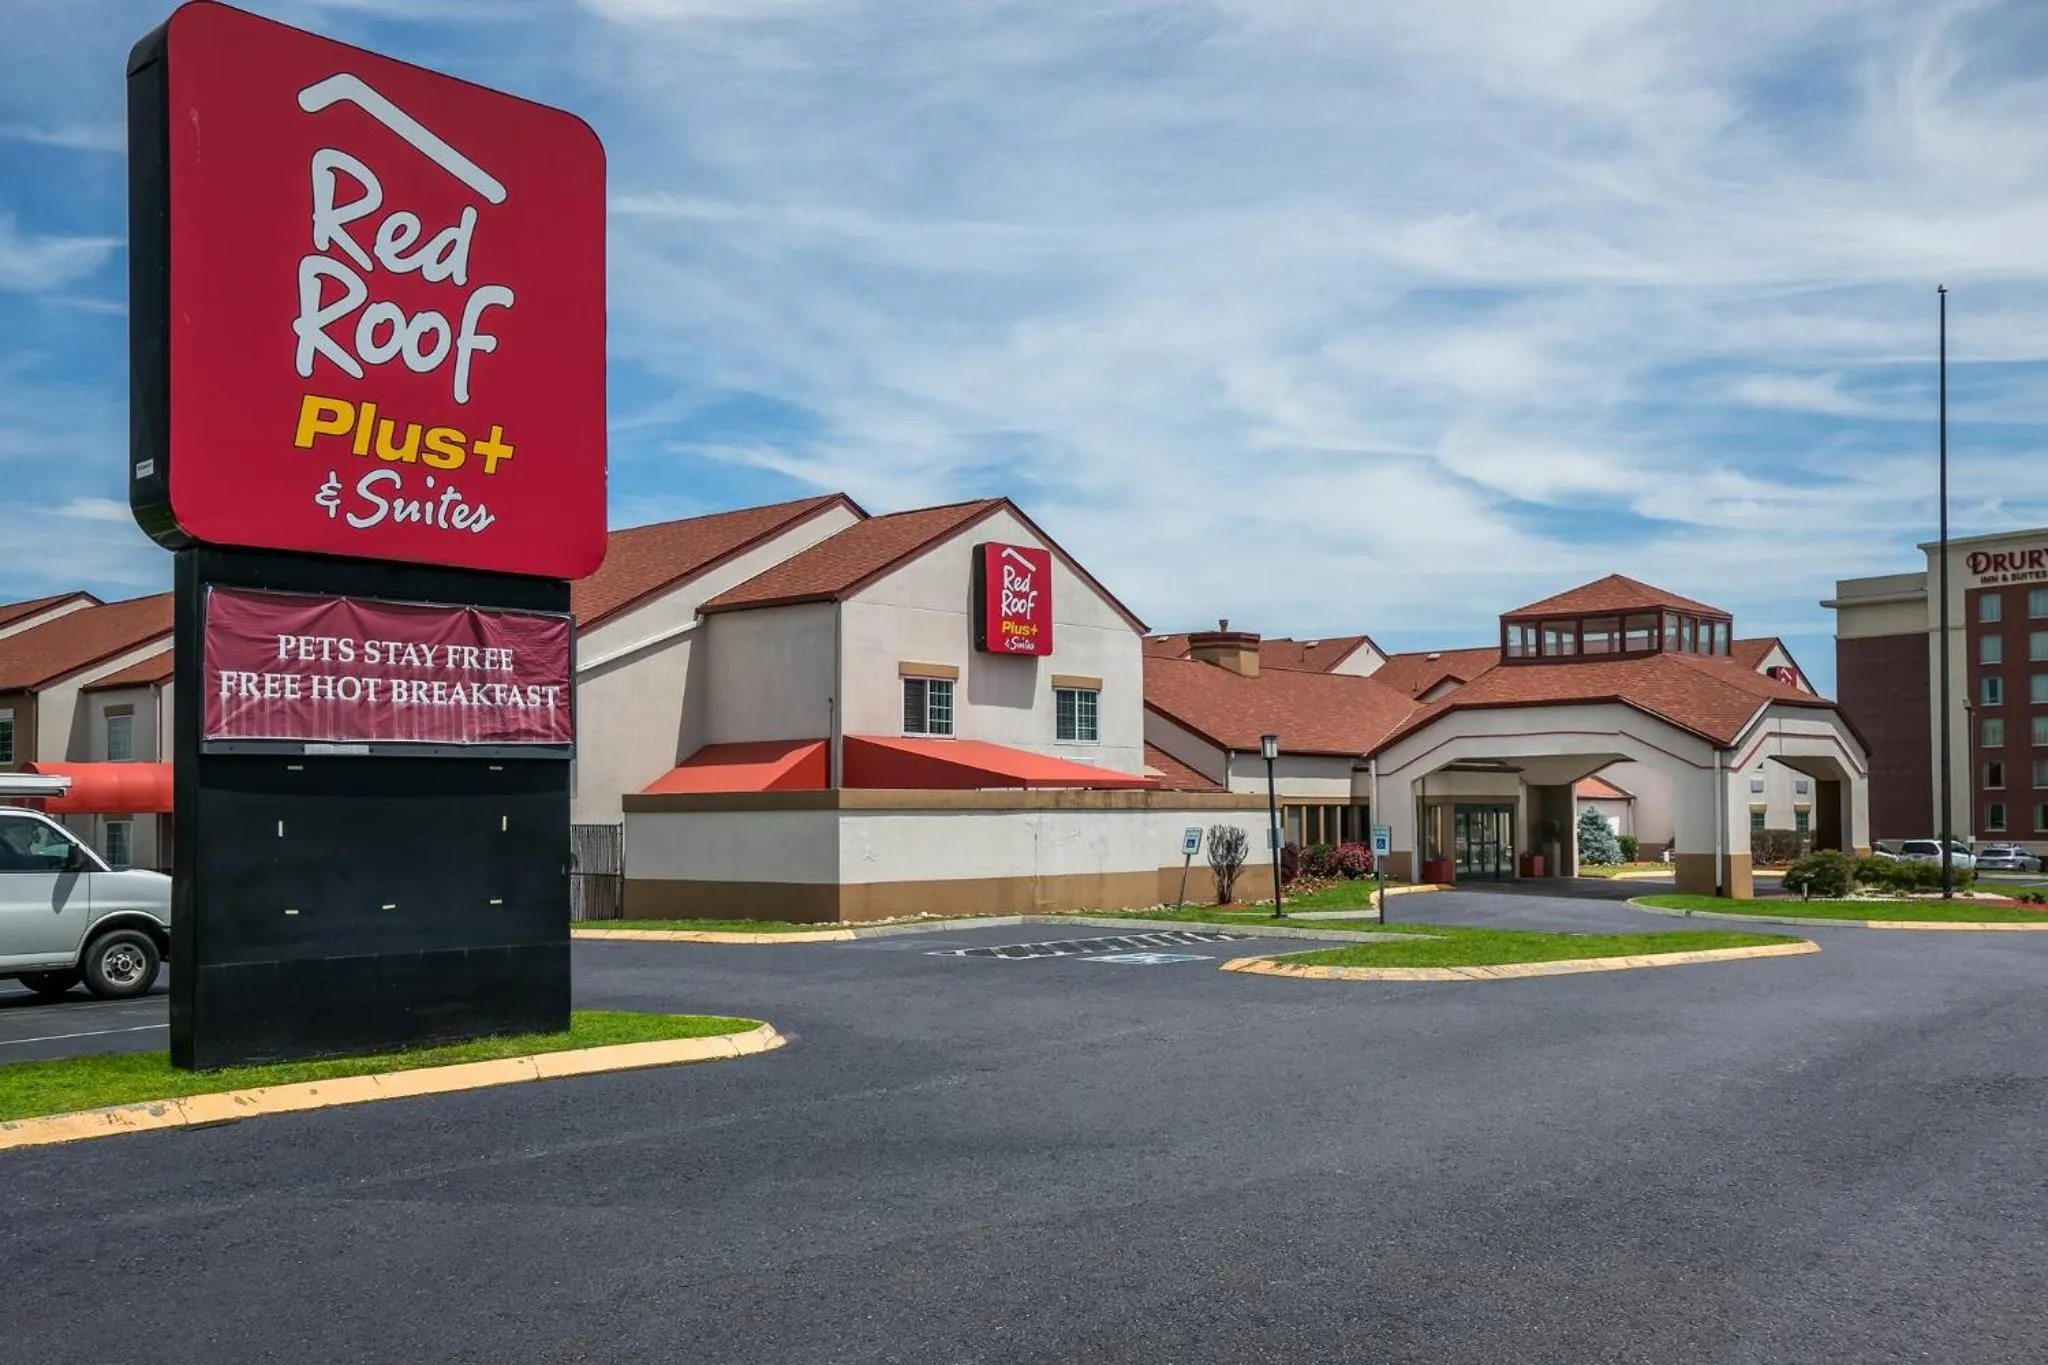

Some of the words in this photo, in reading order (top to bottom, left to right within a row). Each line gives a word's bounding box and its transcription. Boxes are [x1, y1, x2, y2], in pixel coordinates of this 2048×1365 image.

[311, 147, 477, 286] Red
[293, 254, 515, 404] Roof
[294, 393, 516, 475] Plus+
[314, 471, 342, 518] &
[346, 469, 495, 533] Suites
[1003, 565, 1031, 592] Red
[1001, 589, 1038, 620] Roof
[276, 634, 355, 662] PETS
[364, 640, 439, 667] STAY
[446, 645, 513, 671] FREE
[219, 670, 301, 698] FREE
[310, 674, 382, 701] HOT
[391, 679, 560, 707] BREAKFAST
